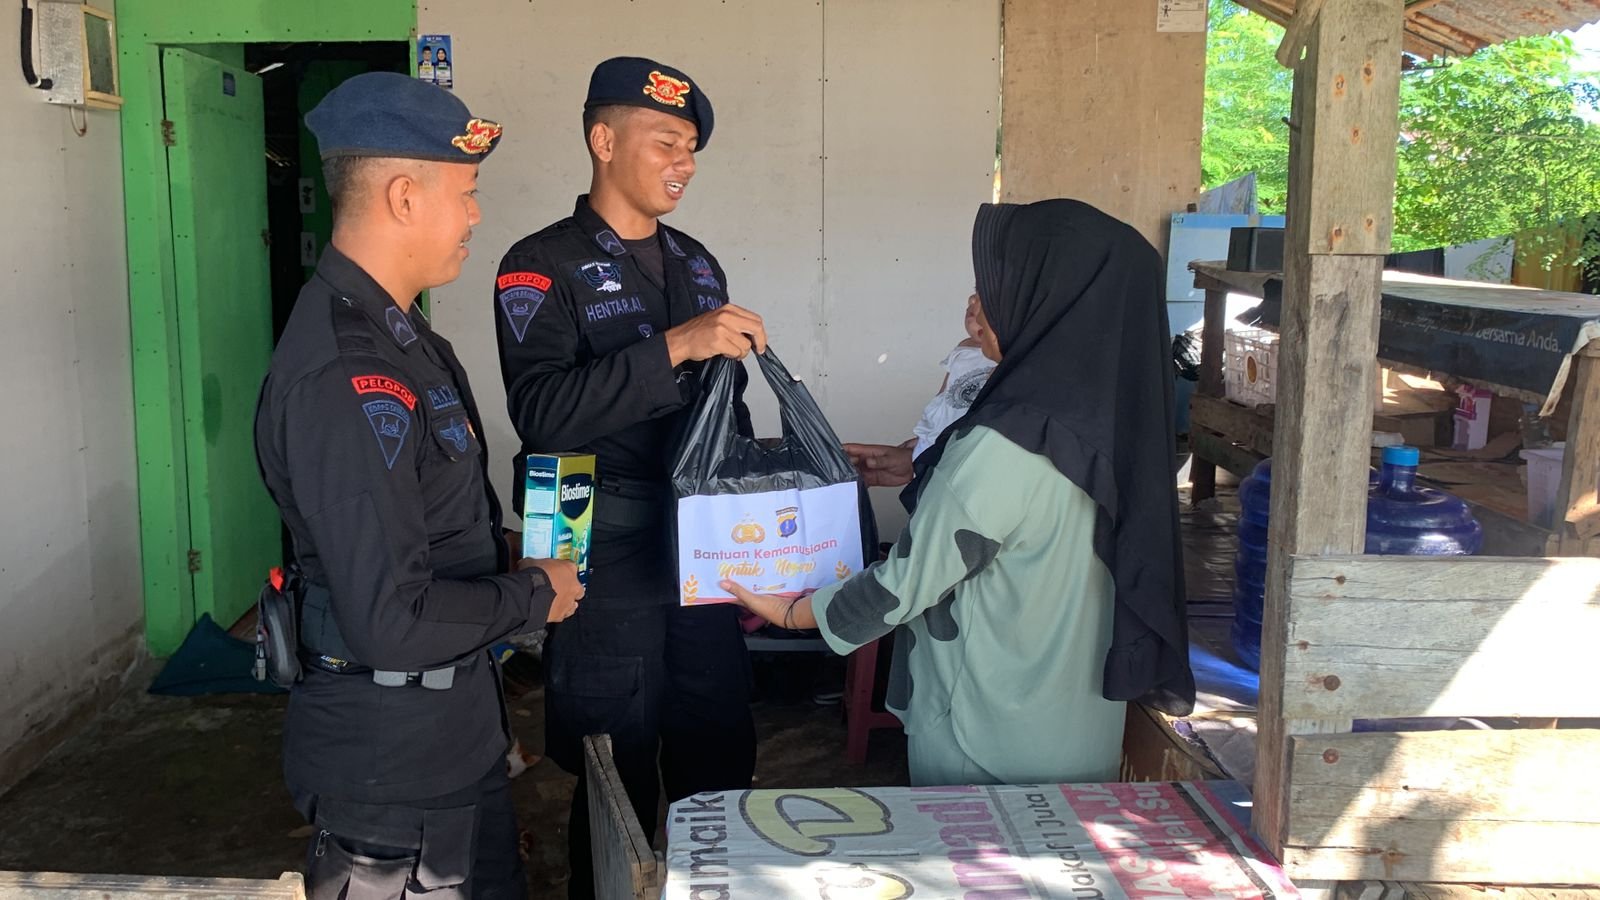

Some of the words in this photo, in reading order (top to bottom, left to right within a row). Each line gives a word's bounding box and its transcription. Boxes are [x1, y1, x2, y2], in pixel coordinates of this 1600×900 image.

[501, 274, 549, 288] PELOPOR
[1526, 329, 1562, 353] Anda.
[359, 380, 414, 403] PELOPOR
[529, 470, 555, 478] Biostime
[561, 482, 590, 502] Biostime
[694, 549, 749, 560] Bantuan
[754, 539, 838, 560] Kemanusiaan
[717, 561, 766, 577] Untuk
